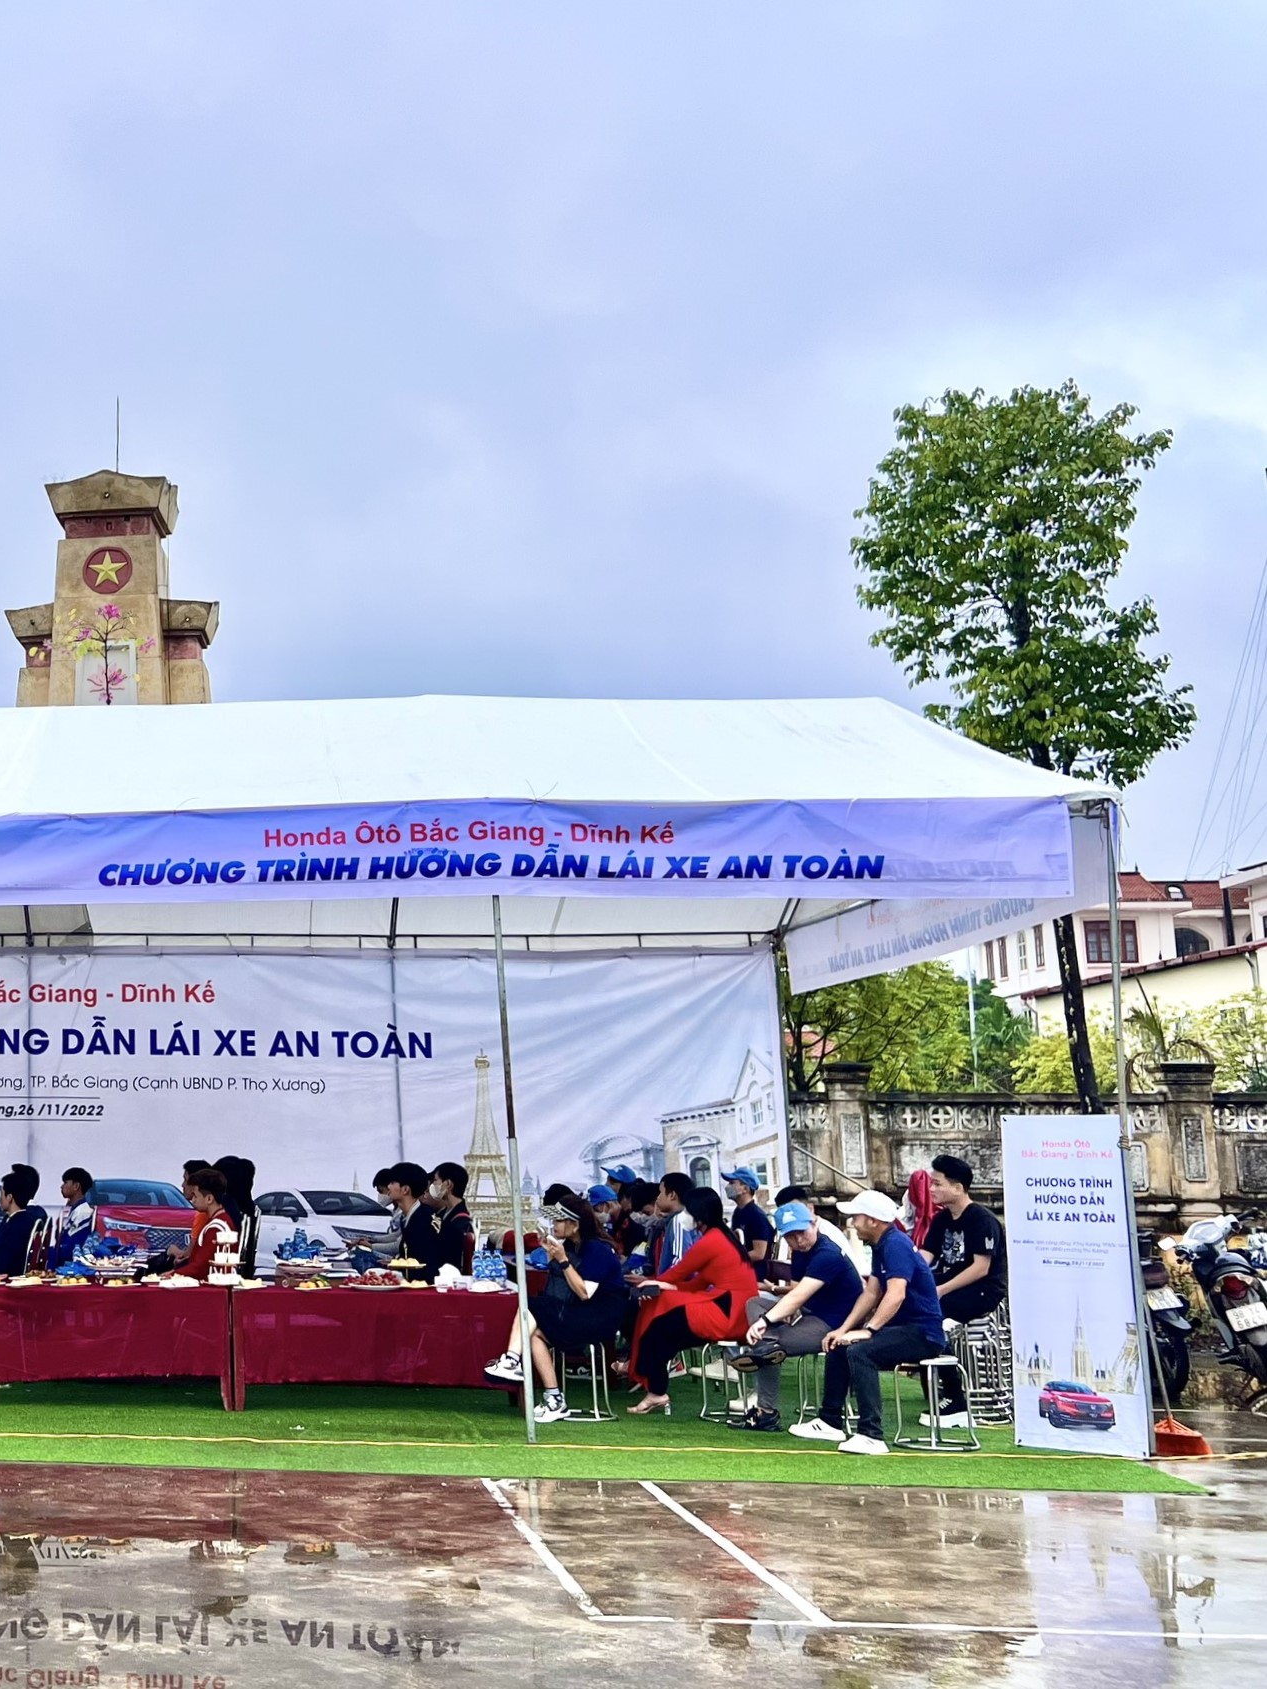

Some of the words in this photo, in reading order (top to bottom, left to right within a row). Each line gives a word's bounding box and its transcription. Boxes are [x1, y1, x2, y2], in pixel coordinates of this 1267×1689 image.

[264, 827, 346, 848] Honda
[355, 821, 401, 844] Ôtô
[410, 818, 459, 843] Bắc
[468, 821, 544, 847] Giang
[571, 823, 630, 844] Dĩnh
[641, 820, 675, 844] Kế
[98, 858, 246, 887] CHƯƠNG
[257, 851, 361, 882] TRÌNH
[368, 847, 502, 880] HƯỚNG
[511, 843, 590, 878] DẪN
[597, 850, 655, 879] LÁI
[662, 856, 711, 879] XE
[717, 855, 773, 880] AN
[782, 848, 885, 880] TOÀN
[29, 984, 97, 1007] Giang
[121, 983, 175, 1003] Dĩnh
[184, 979, 215, 1003] Kế
[62, 1016, 136, 1056] DẪN
[150, 1021, 201, 1057] LÁI
[213, 1030, 256, 1057] XE
[268, 1031, 320, 1058] AN
[332, 1023, 432, 1059] TOÀN
[30, 1076, 47, 1089] TP.
[51, 1073, 79, 1088] Bắc
[84, 1076, 128, 1093] Giang
[132, 1077, 178, 1094] (Cạnh
[183, 1077, 223, 1091] UBND
[227, 1077, 238, 1091] P.
[242, 1077, 268, 1095] Thọ
[272, 1077, 326, 1094] Xương)
[1042, 1140, 1072, 1148] Honda
[1041, 1150, 1069, 1160] Giang
[1026, 1176, 1076, 1188] CHƯƠNG
[1080, 1175, 1113, 1188] TRÌNH
[1035, 1192, 1077, 1205] HƯỚNG
[1026, 1209, 1043, 1221] LÁI
[1047, 1212, 1061, 1222] XE
[1064, 1213, 1080, 1222] AN
[1084, 1211, 1116, 1223] TOÀN
